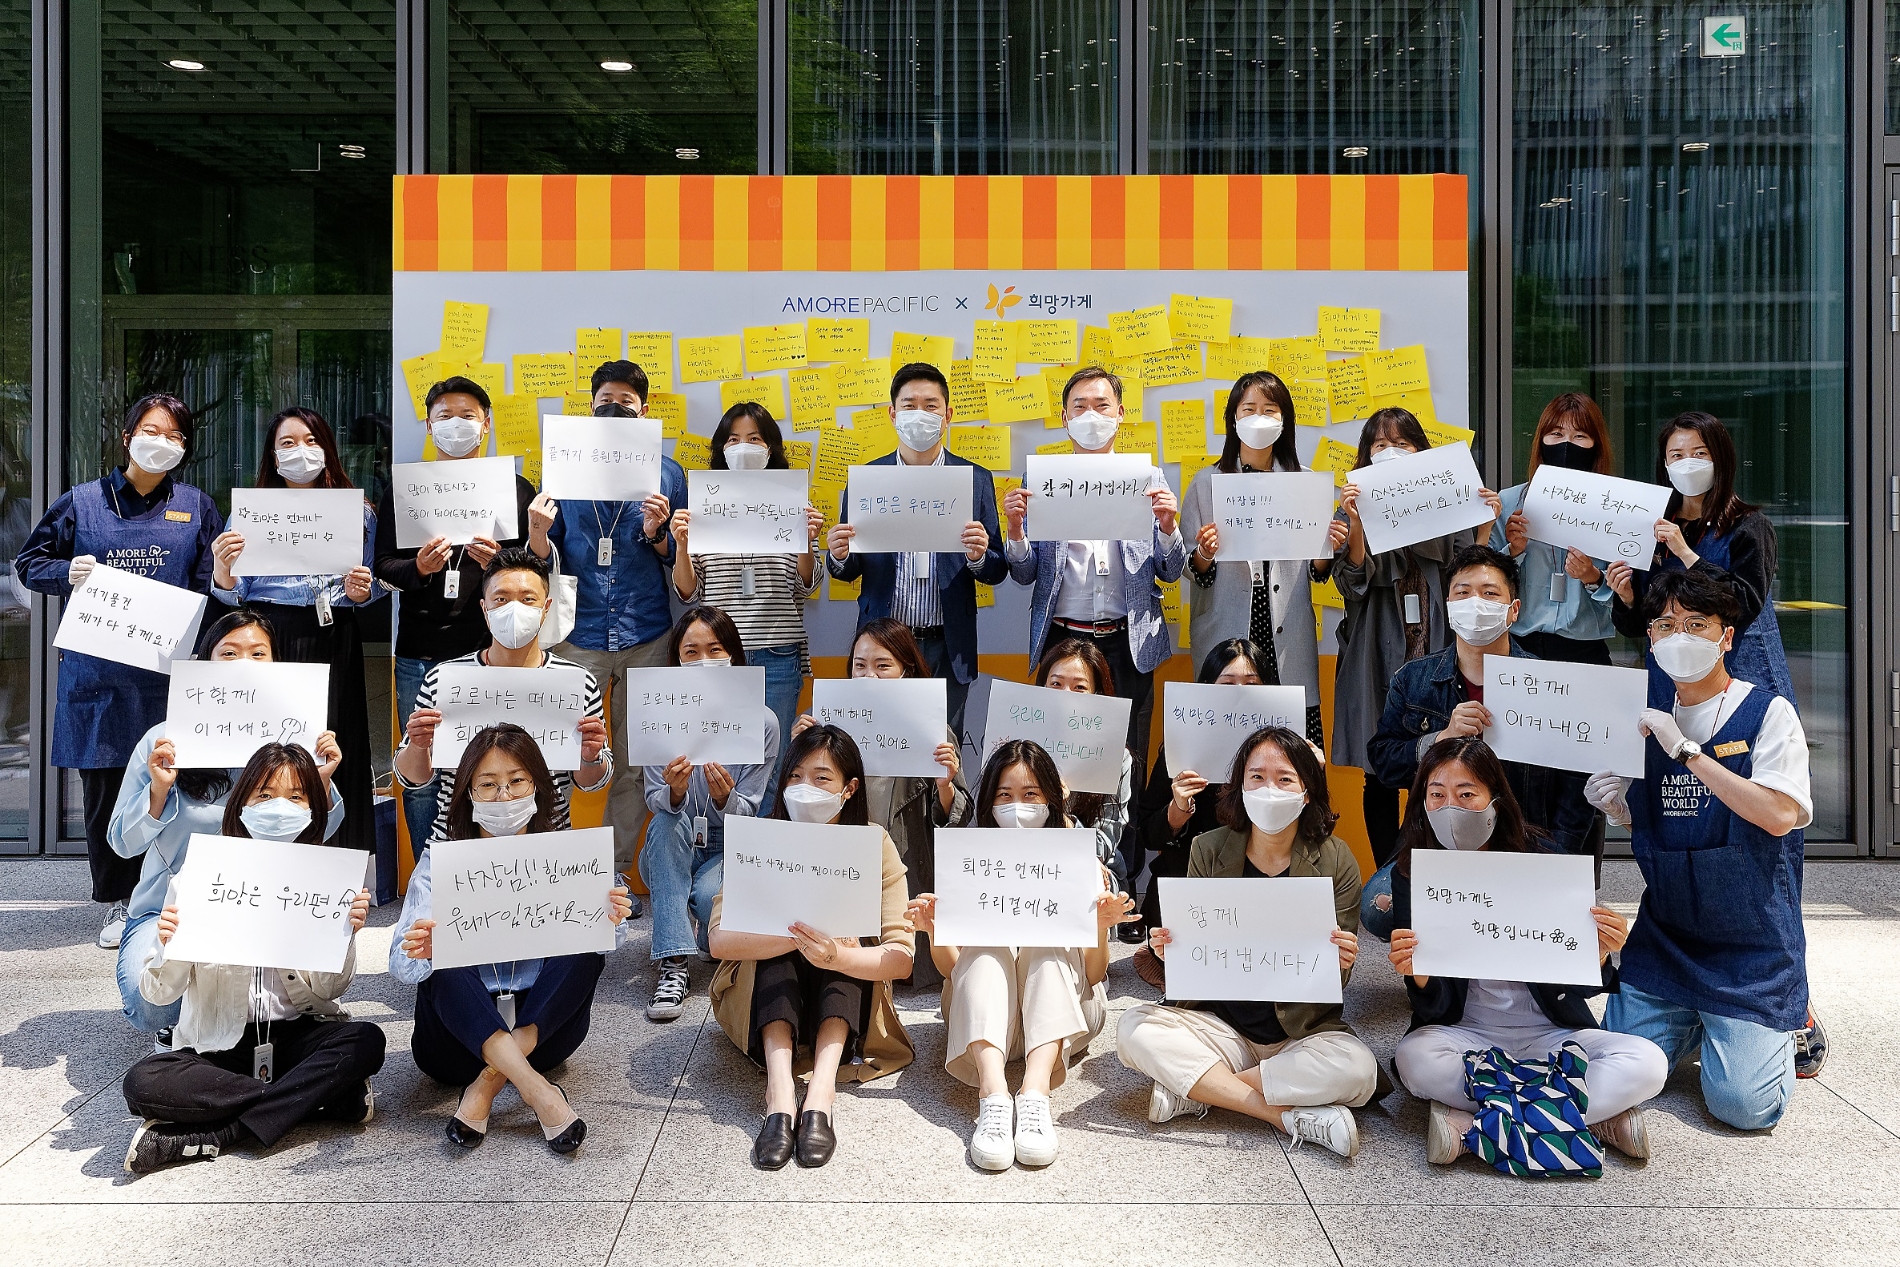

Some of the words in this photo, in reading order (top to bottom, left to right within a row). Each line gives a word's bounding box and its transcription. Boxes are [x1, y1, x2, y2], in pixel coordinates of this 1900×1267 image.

[782, 295, 939, 313] AMOREPACIFIC
[1028, 293, 1092, 315] 희망가게
[549, 445, 582, 463] 끝까지
[590, 448, 656, 465] 응원합니다!
[408, 483, 430, 496] 많이
[702, 498, 738, 519] 희망은
[860, 496, 901, 514] 희망은
[908, 498, 957, 516] 우리편!
[1226, 495, 1272, 507] 사장님!!!
[1543, 485, 1587, 505] 사장님은
[1600, 490, 1650, 515] 혼자가
[251, 511, 280, 524] 희망은
[286, 512, 323, 524] 언제나
[1225, 518, 1254, 528] 저희만
[266, 530, 318, 546] 우리곁에
[106, 550, 114, 558] A
[116, 550, 147, 558] MORE
[106, 558, 166, 568] BEAUTIFUL
[78, 612, 102, 627] 제가
[106, 618, 120, 631] 다
[449, 686, 517, 710] 코로나는
[528, 692, 580, 710] 떠나고
[642, 692, 704, 706] 코로나보다
[820, 706, 873, 724] 함께하면
[1009, 704, 1045, 725] 우리의
[1068, 709, 1103, 731] 희망을
[194, 720, 274, 738] 이겨내요
[640, 720, 672, 735] 우리가
[680, 721, 690, 734] 더
[700, 720, 743, 736] 강합니다
[860, 736, 870, 750] 수
[876, 734, 910, 750] 있어요
[1718, 744, 1745, 756] STAFF
[1662, 775, 1670, 785] A
[1671, 774, 1698, 786] MORE
[1662, 786, 1714, 798] BEAUTIFU
[1662, 798, 1700, 809] WORLD
[454, 858, 538, 893] 사장님!!
[542, 858, 608, 885] 힘내세요
[766, 858, 804, 874] 사장님이
[811, 866, 848, 878] 찐이야
[962, 857, 1006, 881] 희망은
[1014, 863, 1062, 882] 언제나
[208, 873, 262, 907] 희망은
[276, 886, 330, 918] 우리편
[978, 892, 1040, 918] 우리곁에
[1426, 885, 1494, 908] 희망가게는
[446, 906, 501, 942] 우리가
[1188, 903, 1238, 930] 함께
[1472, 918, 1548, 942] 희망입니다
[1191, 944, 1320, 979] 이겨냅시다!
